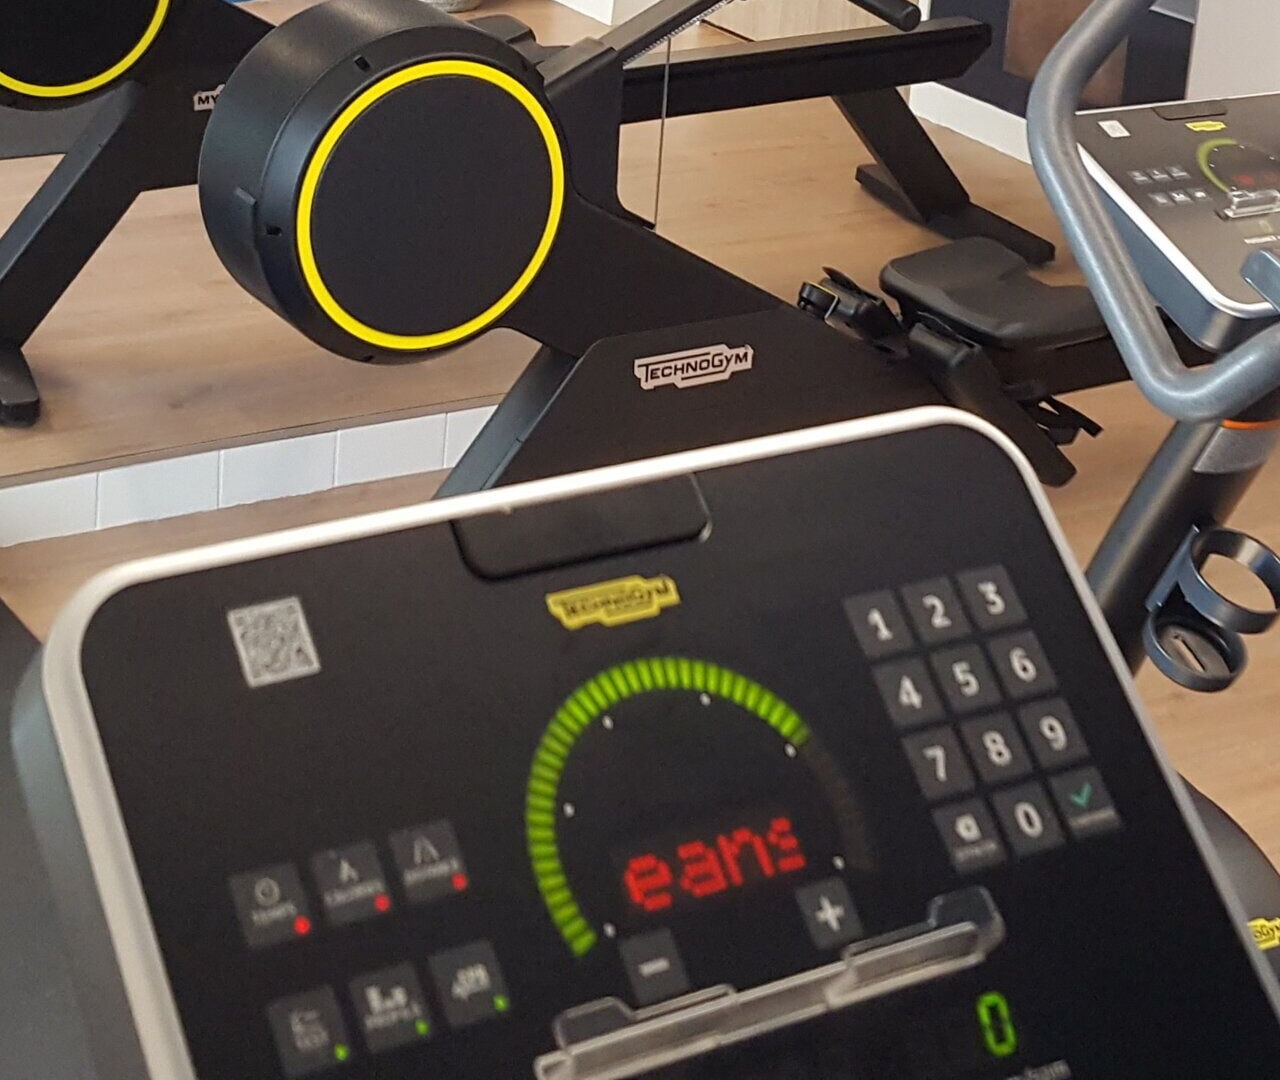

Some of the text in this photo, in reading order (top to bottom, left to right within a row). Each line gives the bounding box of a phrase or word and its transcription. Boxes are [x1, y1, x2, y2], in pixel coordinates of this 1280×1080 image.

[867, 580, 1006, 641] 1 2 3
[898, 646, 1037, 709] 4 5 6
[922, 714, 1068, 782] 7 8 9
[1013, 801, 1043, 838] 0
[976, 990, 1018, 1057] 0
